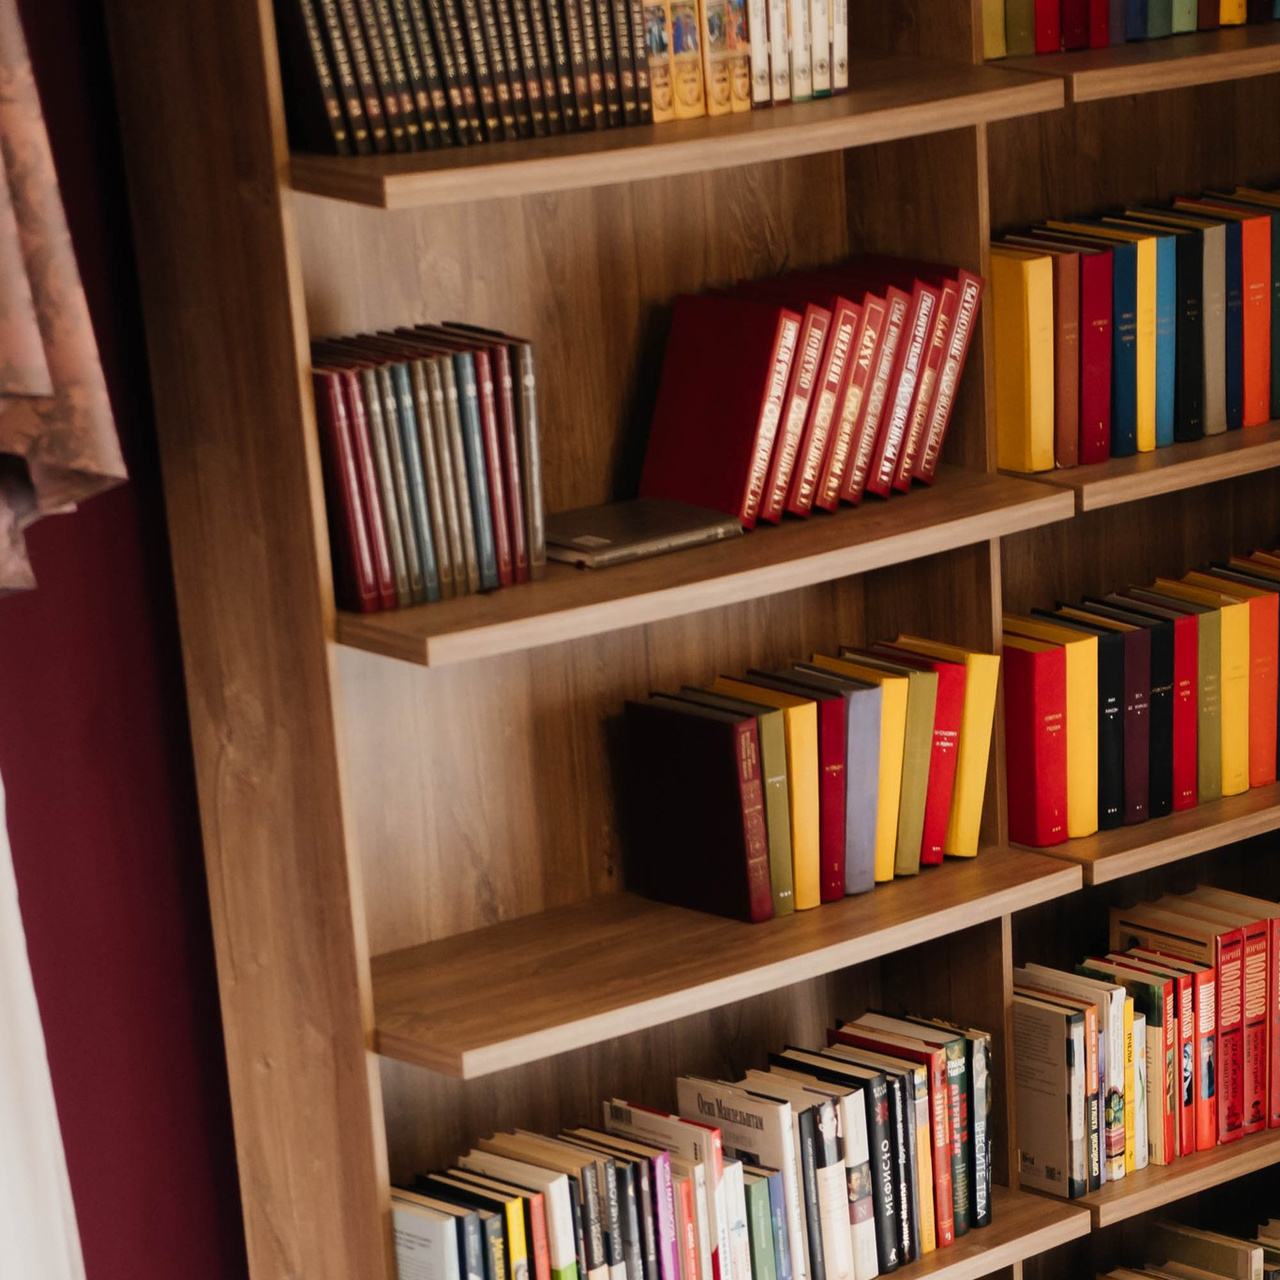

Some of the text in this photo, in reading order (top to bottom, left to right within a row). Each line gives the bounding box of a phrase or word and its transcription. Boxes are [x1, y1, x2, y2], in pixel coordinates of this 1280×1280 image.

[853, 326, 875, 370] АХРУ
[931, 314, 948, 347] ПРУД
[930, 394, 951, 443] РЕМИЗОВ
[950, 284, 978, 361] ЛИМОНАРЬ
[752, 433, 772, 481] РЕМИЗОВ
[1221, 949, 1241, 961] ЮРИЙ
[1246, 940, 1266, 953] ЮРИЙ
[1199, 981, 1215, 1034] ПОЛЯКОВ
[1221, 960, 1241, 1027] ПОЛЯКОВ
[1246, 953, 1266, 1018] ПОЛЯКОВ
[1166, 993, 1174, 1046] ПОЛЯКОВ
[1182, 987, 1192, 1039] ПОЛЯКОВ
[715, 1099, 765, 1131] Мандельштам
[974, 1121, 987, 1219] ВНЕСИТЕ ТЕЛА
